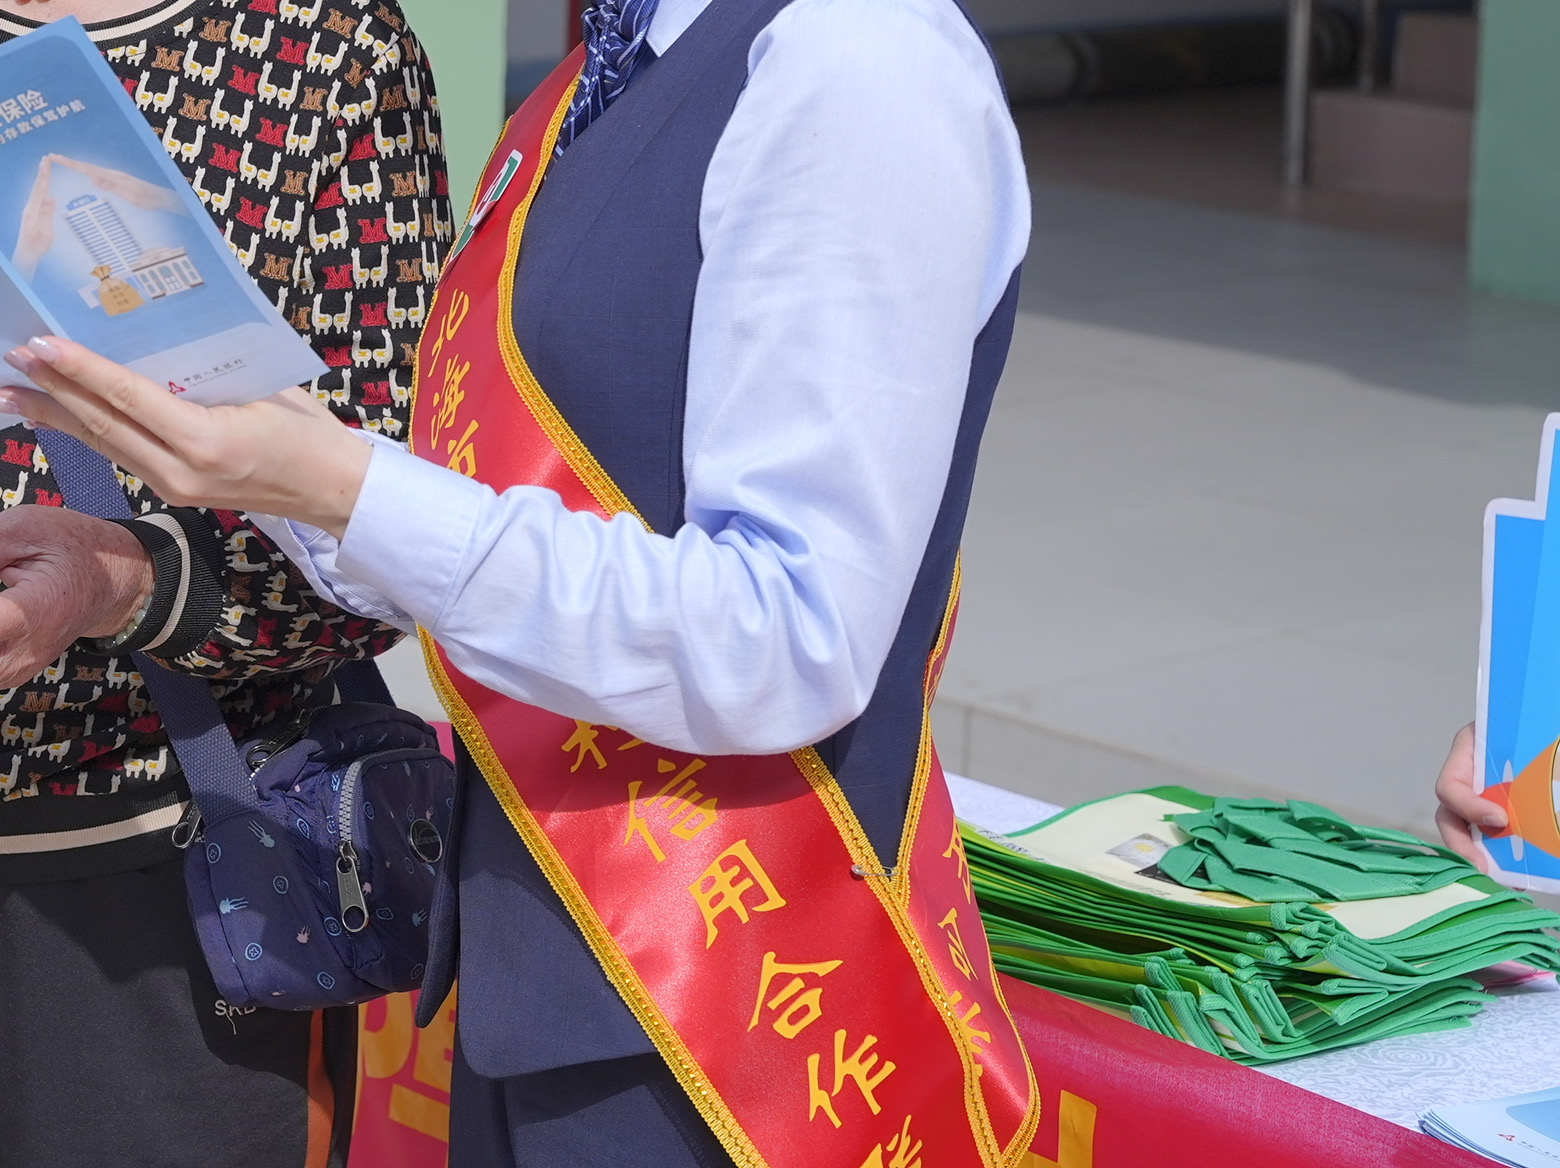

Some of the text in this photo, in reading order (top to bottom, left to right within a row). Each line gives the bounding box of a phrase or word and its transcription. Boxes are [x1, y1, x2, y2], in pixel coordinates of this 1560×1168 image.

[324, 10, 355, 36] M
[377, 2, 402, 31] M
[199, 19, 230, 42] M
[153, 48, 182, 70] M
[279, 39, 308, 63] M
[231, 67, 259, 93] M
[180, 96, 209, 119] M
[301, 88, 326, 110] M
[381, 88, 406, 110] M
[258, 119, 287, 146] M
[211, 145, 241, 171] M
[351, 135, 376, 159] M
[282, 171, 307, 194] M
[390, 172, 417, 196] M
[317, 184, 343, 208] M
[239, 199, 267, 227] M
[360, 219, 388, 242] M
[261, 255, 291, 280] M
[325, 265, 352, 288] M
[397, 259, 422, 281] M
[362, 304, 387, 325] M
[325, 347, 351, 365] M
[363, 382, 391, 404] M
[3, 441, 34, 465] M
[75, 665, 104, 682] M
[24, 692, 51, 711] M
